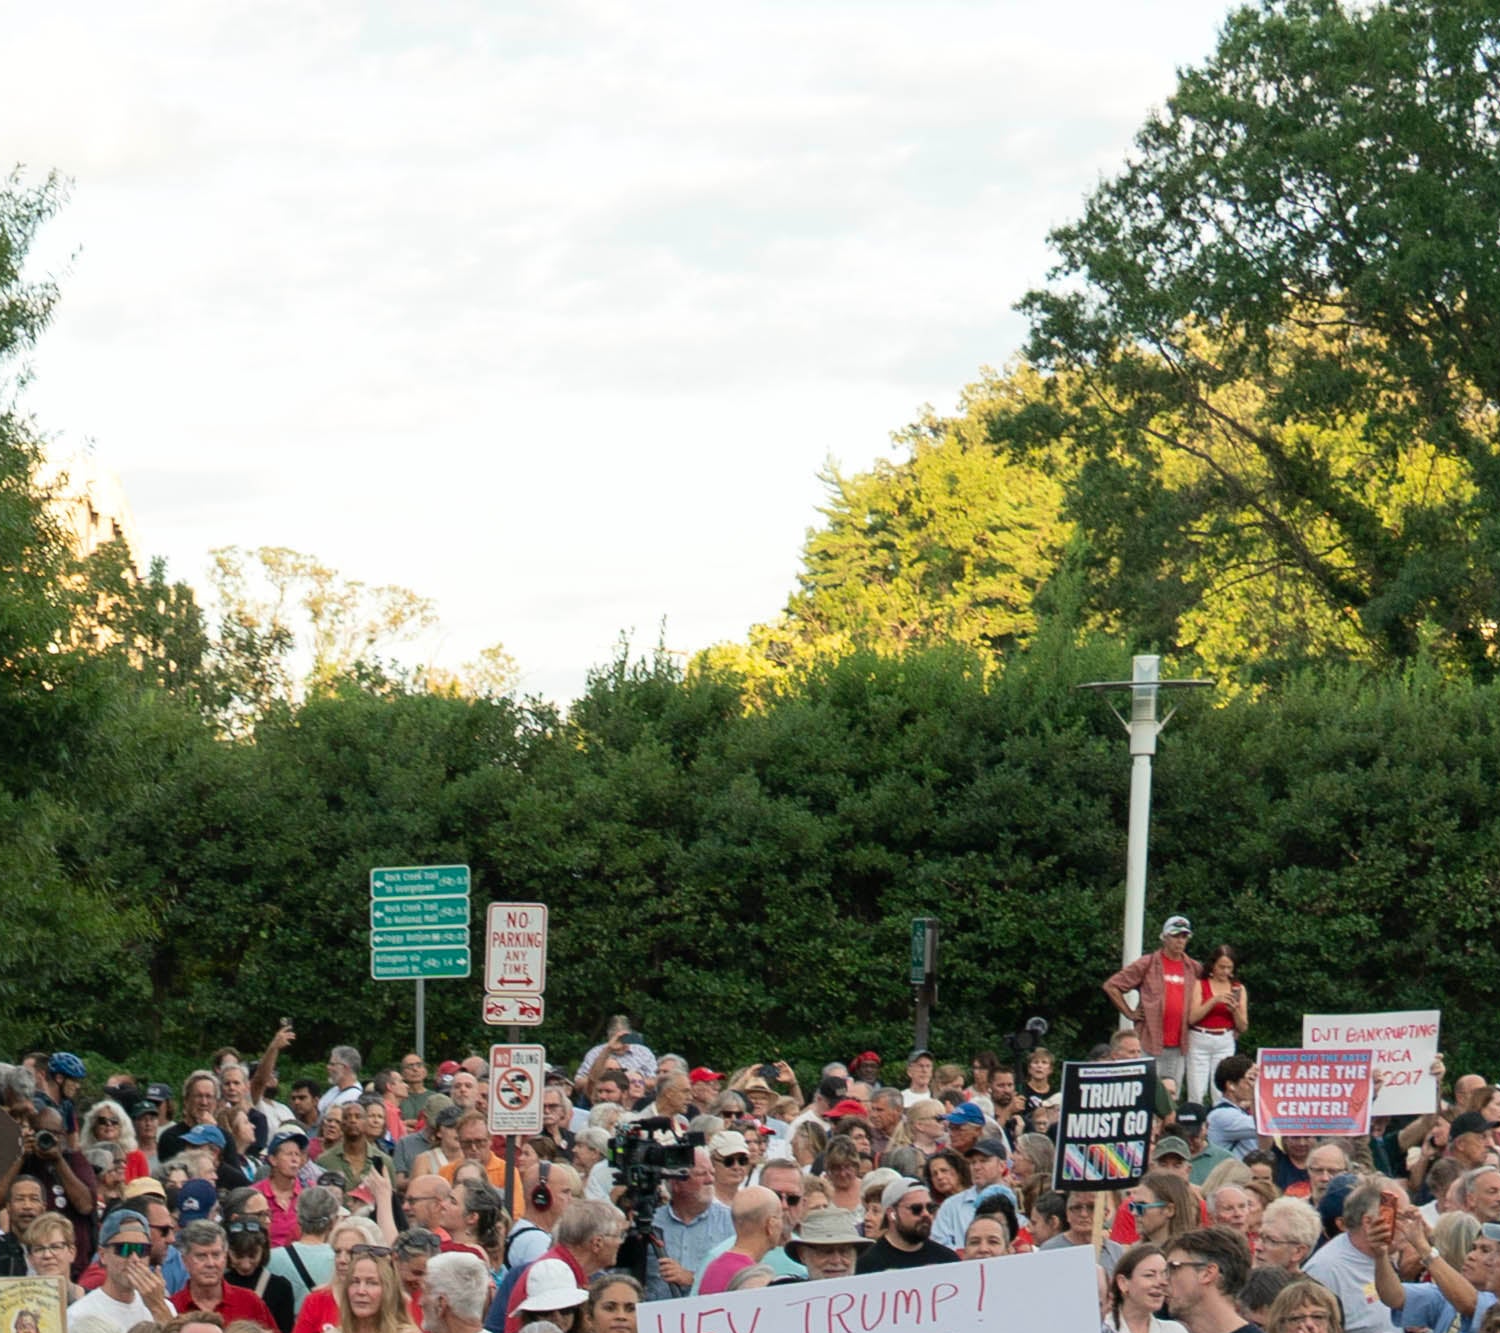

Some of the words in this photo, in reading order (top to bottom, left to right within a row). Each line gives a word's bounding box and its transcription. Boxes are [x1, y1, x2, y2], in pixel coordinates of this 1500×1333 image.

[507, 911, 528, 929] NO
[492, 931, 543, 948] PARKING
[505, 950, 527, 961] ANY
[503, 963, 529, 975] TIME
[1311, 1026, 1340, 1043] DJT
[1345, 1024, 1438, 1043] BANKRUPTING
[495, 1052, 509, 1065] NO
[1377, 1049, 1412, 1064] RICA
[1263, 1064, 1292, 1080] WE
[1295, 1064, 1330, 1080] ARE
[1334, 1064, 1368, 1080] THE
[1079, 1081, 1143, 1109] TRUMP
[1272, 1082, 1355, 1098] KENNEDY
[1276, 1100, 1349, 1117] CENTER!
[1066, 1112, 1122, 1139] MUST
[1123, 1110, 1149, 1135] GO
[1062, 1140, 1146, 1181] NOW!
